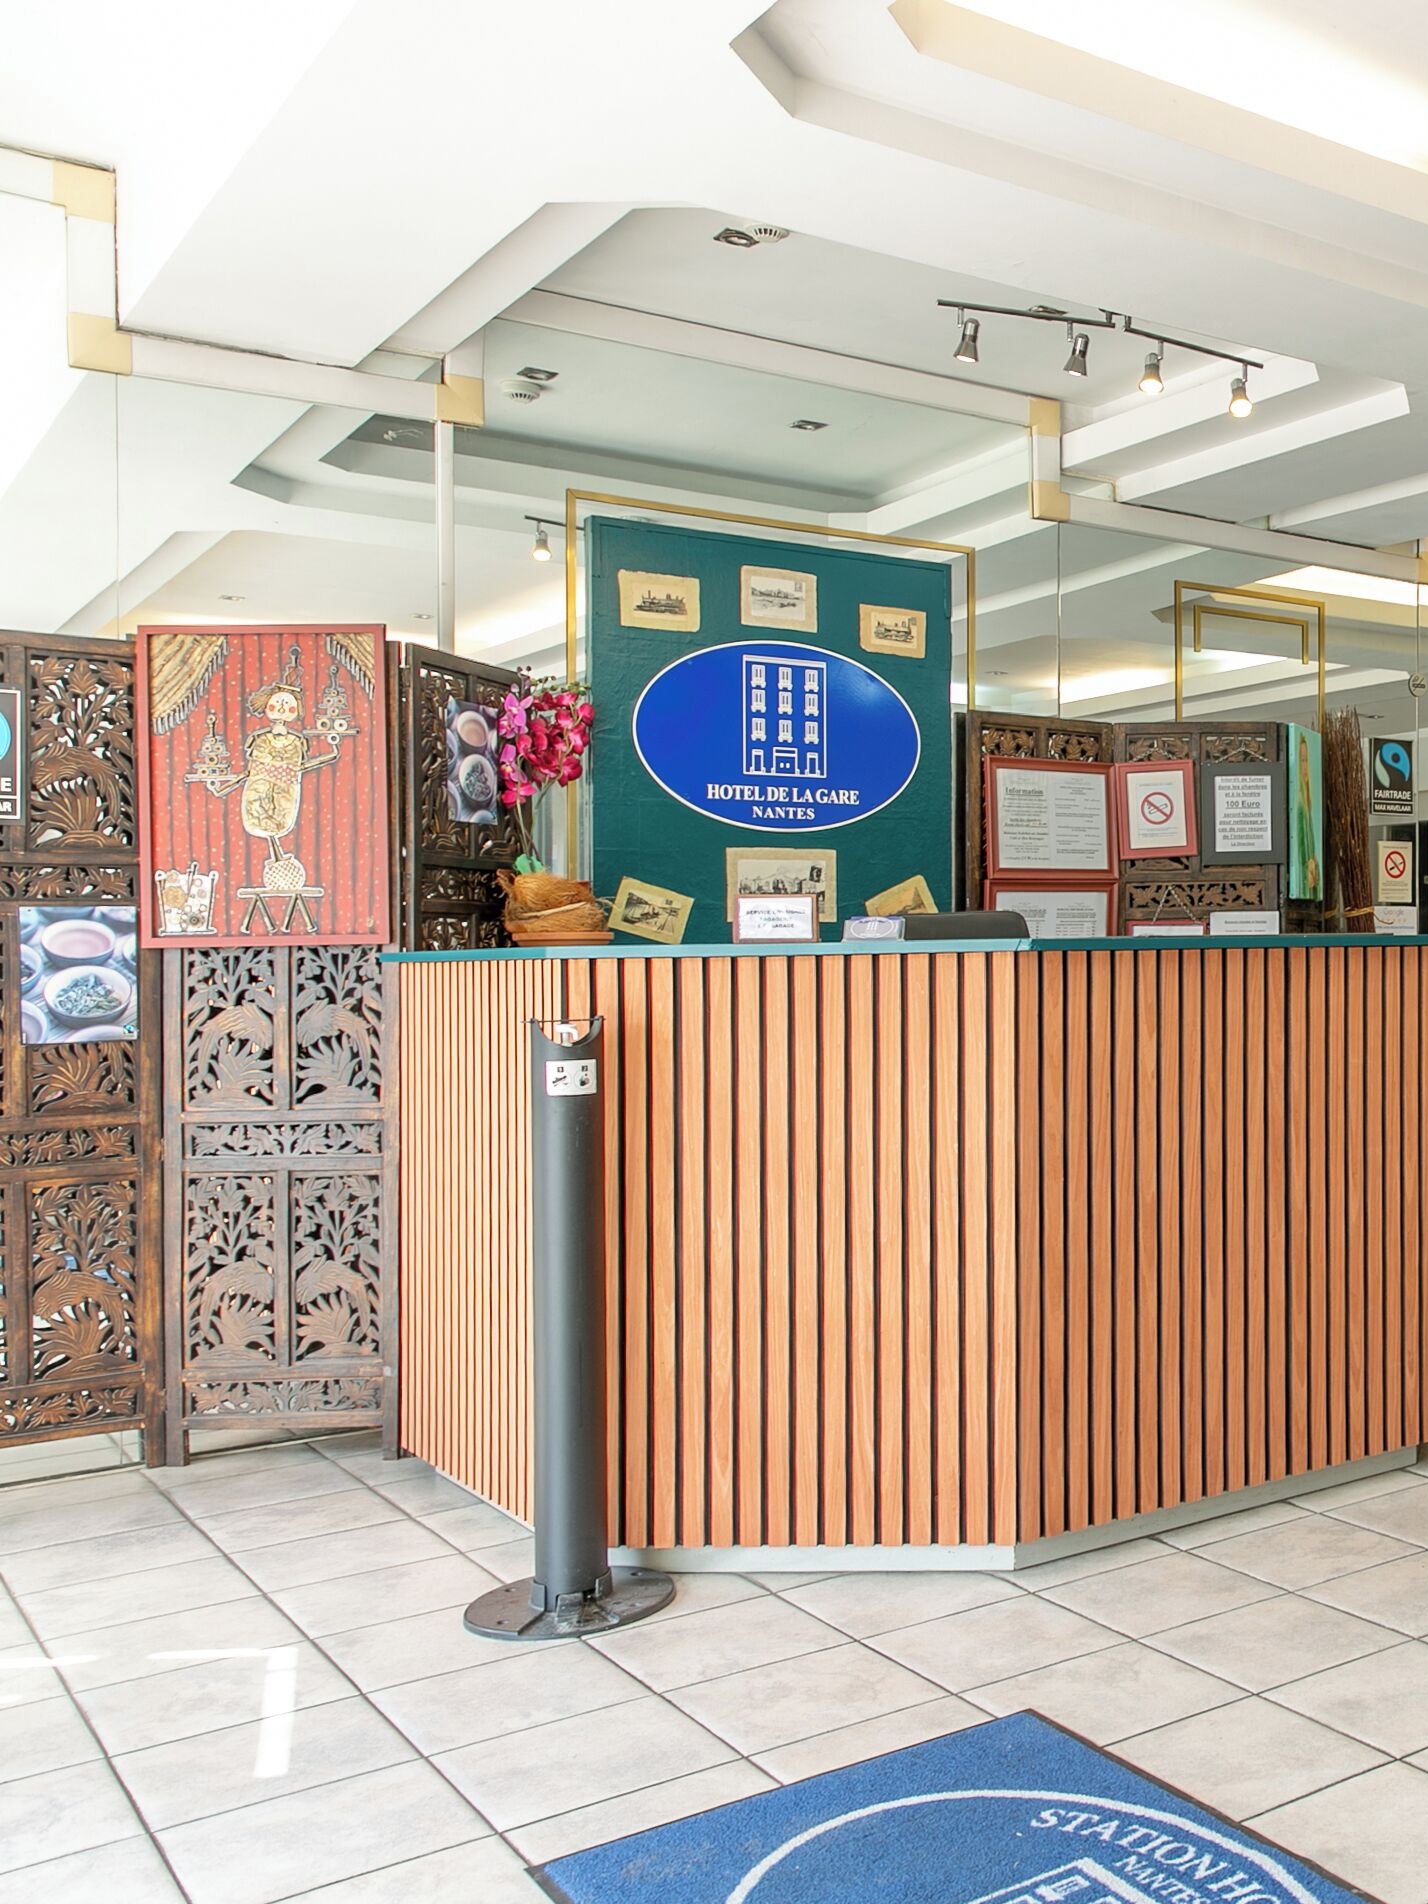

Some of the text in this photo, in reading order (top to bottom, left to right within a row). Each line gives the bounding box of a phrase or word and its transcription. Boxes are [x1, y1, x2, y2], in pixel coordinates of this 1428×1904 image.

[706, 783, 860, 805] HOTEL DE LA GARE
[1374, 789, 1411, 800] FAIRTRADE
[752, 805, 815, 820] NANTES
[1374, 803, 1386, 811] MAX
[1030, 1808, 1229, 1880] STATION
